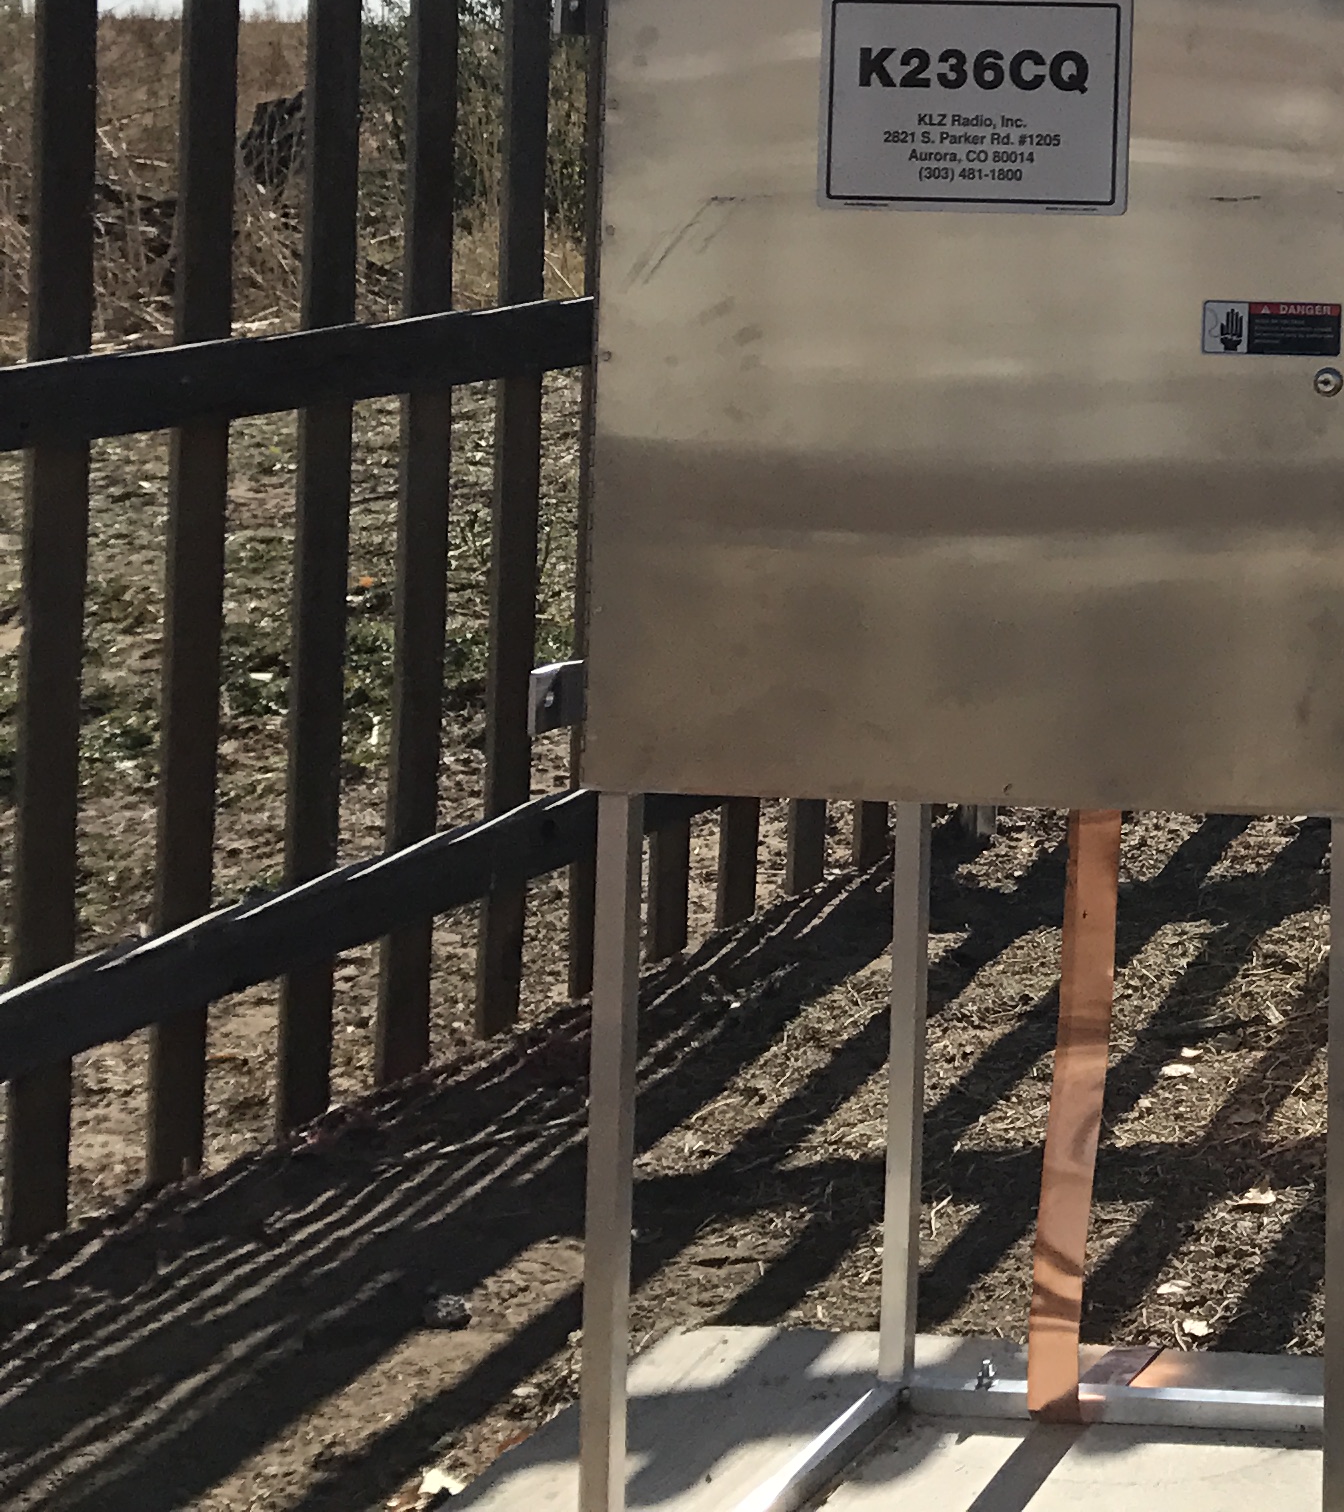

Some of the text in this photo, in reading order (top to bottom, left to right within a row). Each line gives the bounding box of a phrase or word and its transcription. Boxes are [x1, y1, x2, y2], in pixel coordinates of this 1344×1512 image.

[858, 47, 1089, 95] K236CQ
[917, 114, 1027, 130] KLZ Radio, Inc.
[883, 131, 1061, 147] 2821 S. Parker Rd. #1205
[908, 150, 1035, 164] Aurora, CO 80014
[918, 167, 1023, 183] (303) 481-1800
[1279, 304, 1332, 315] DANGER
